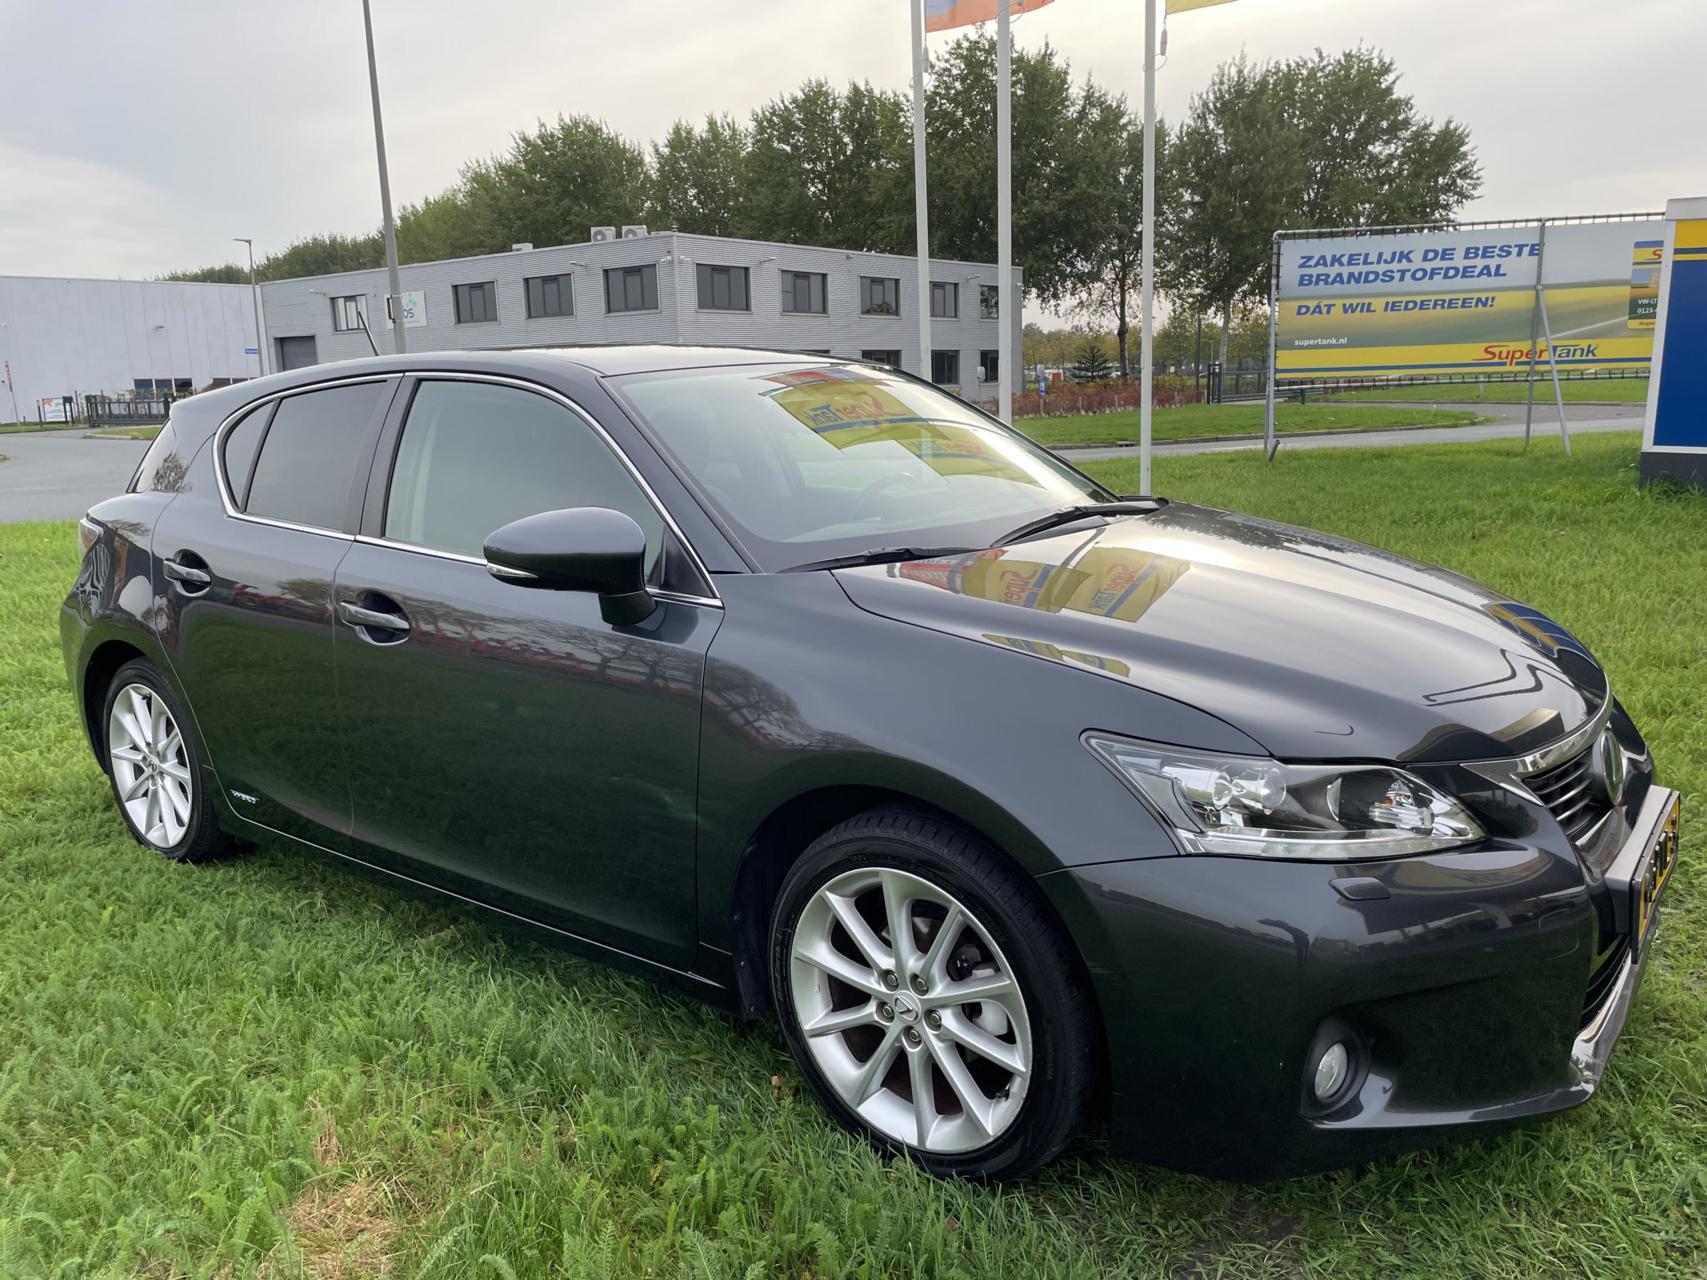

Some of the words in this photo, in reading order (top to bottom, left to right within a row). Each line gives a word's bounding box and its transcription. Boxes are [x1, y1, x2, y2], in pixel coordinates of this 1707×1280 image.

[1297, 249, 1415, 269] ZAKELIJK
[1421, 247, 1456, 263] DE
[1463, 242, 1541, 260] BESTE
[1297, 263, 1507, 288] BRANDSTOFDEAL
[1295, 300, 1336, 316] DÁT
[1341, 301, 1377, 314] WIL
[1383, 295, 1496, 313] IEDEREEN!
[1294, 336, 1347, 347] supertank.nl
[1472, 343, 1599, 367] SuperTank
